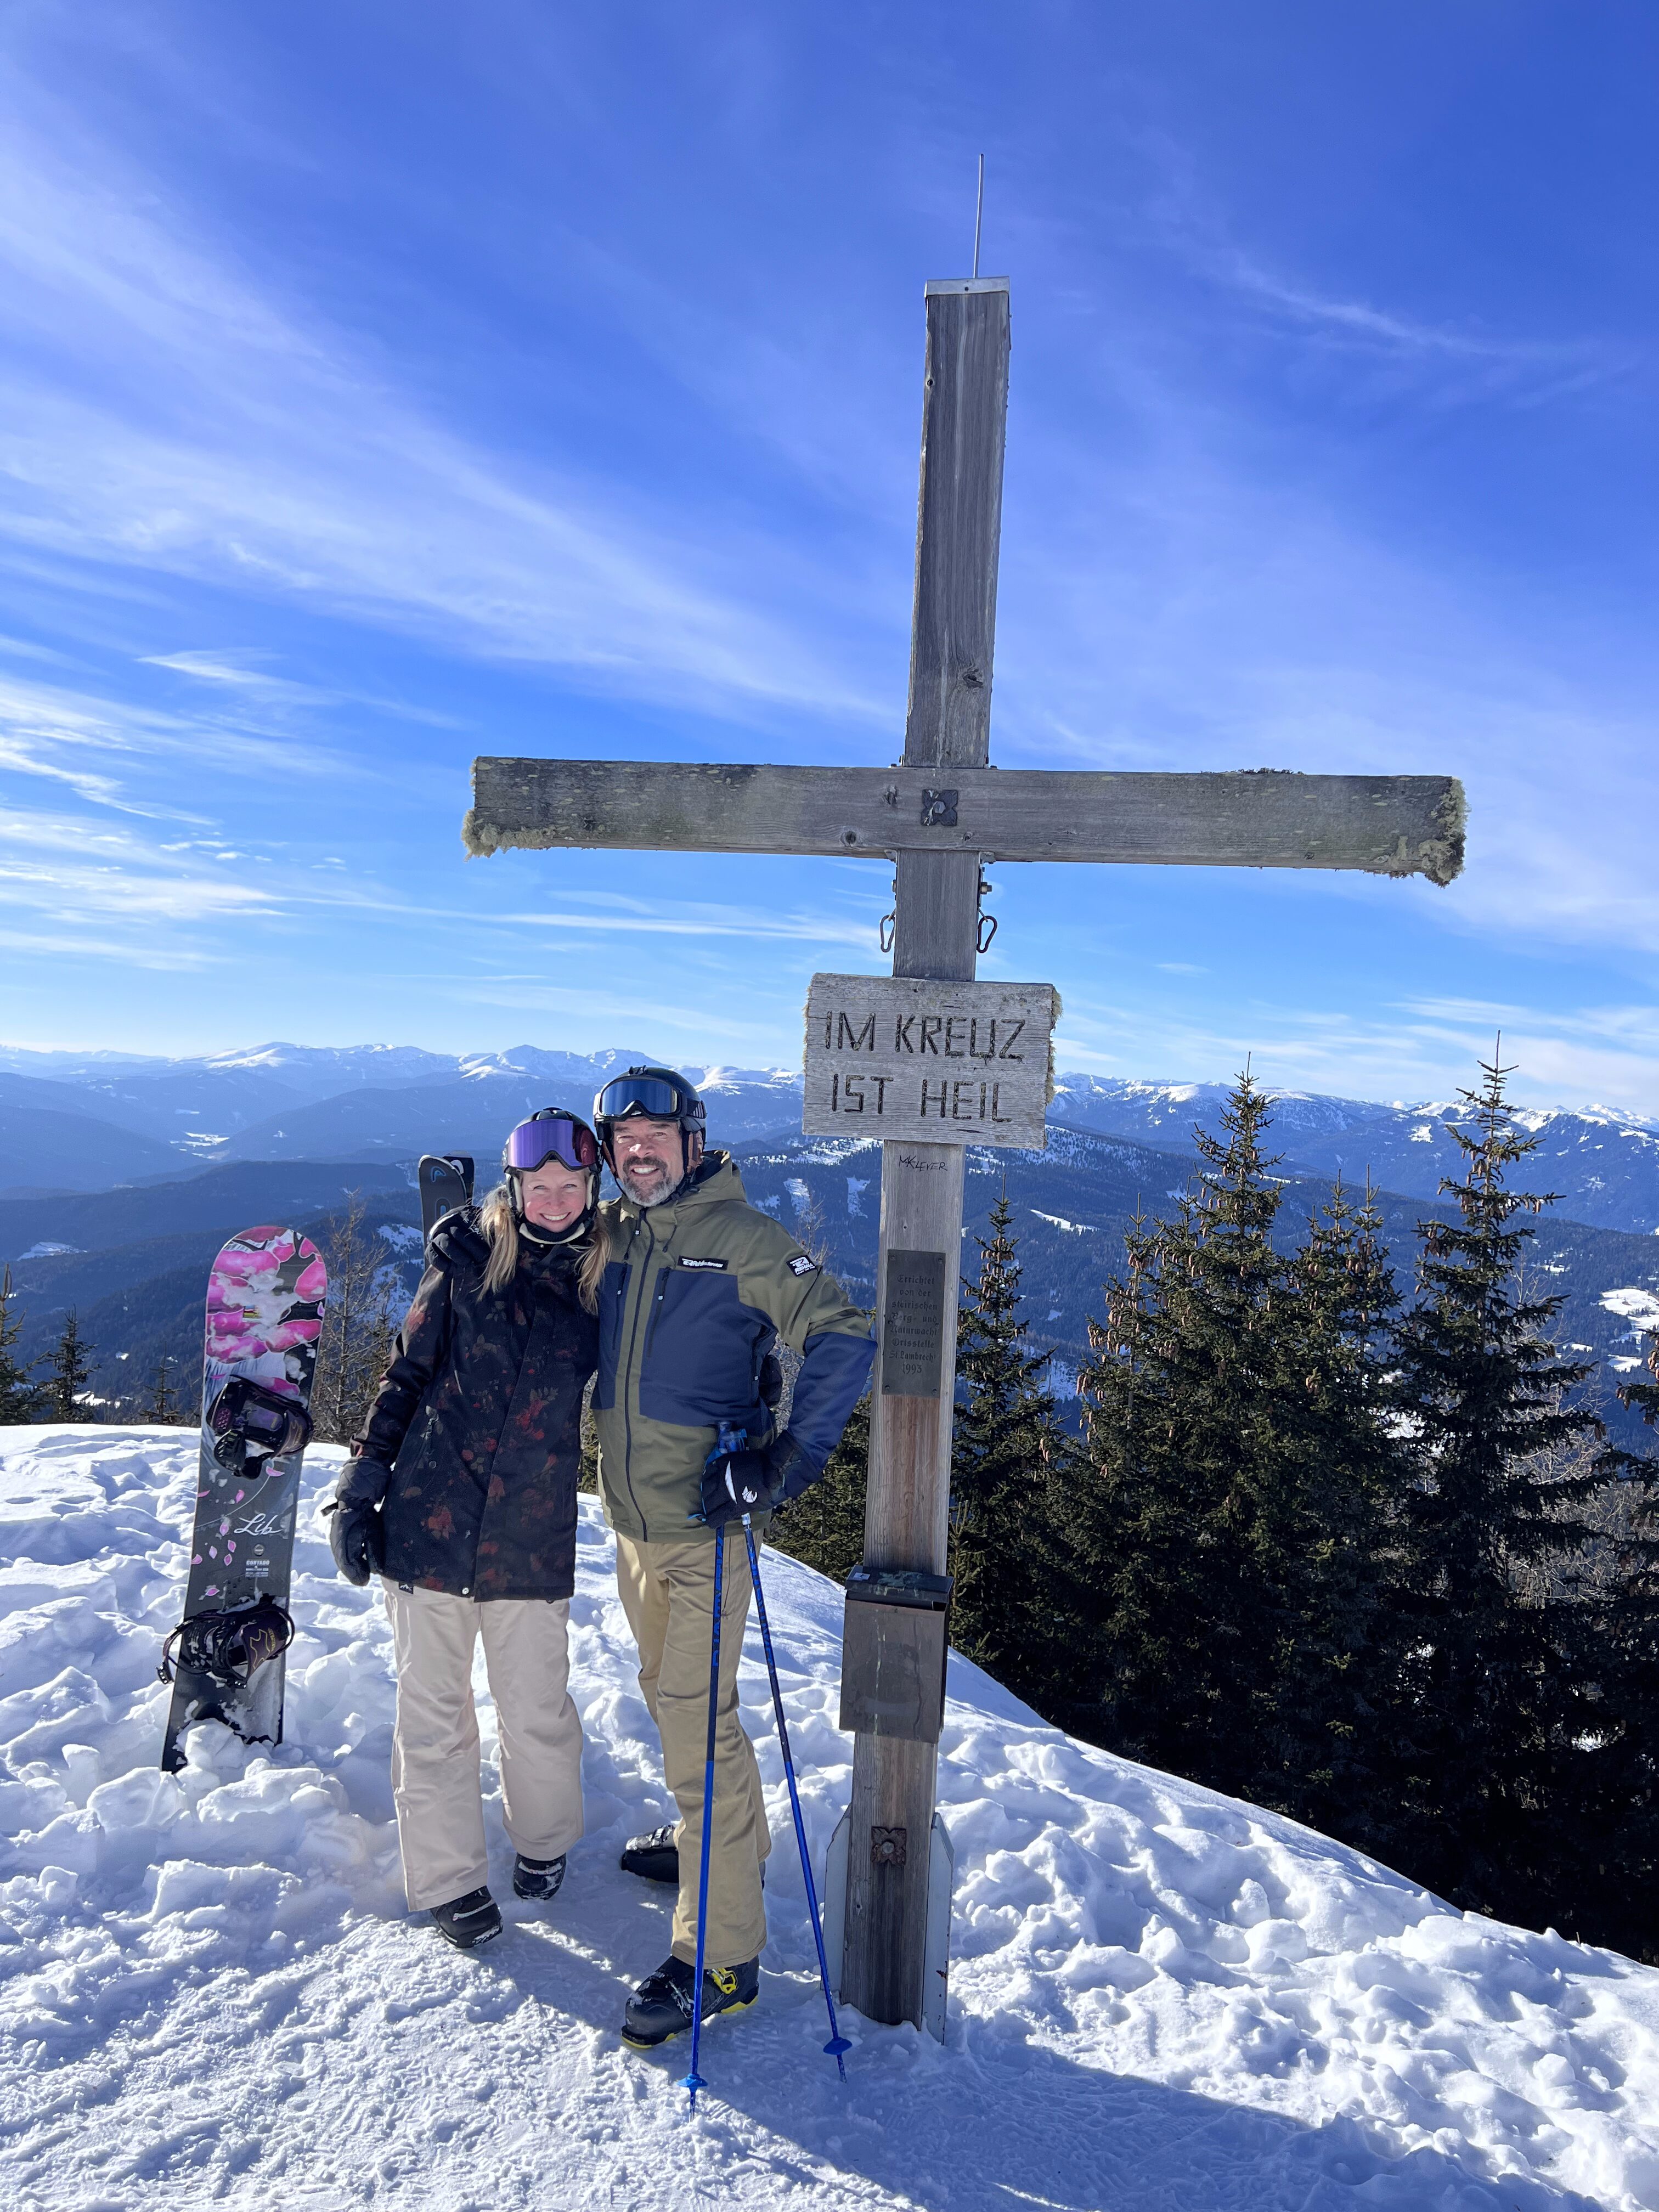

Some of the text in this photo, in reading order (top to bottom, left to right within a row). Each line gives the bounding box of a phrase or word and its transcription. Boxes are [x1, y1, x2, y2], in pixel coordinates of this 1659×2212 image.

[825, 1010, 1026, 1062] IM KREUZ
[831, 1073, 1012, 1122] IST HEIL
[897, 1274, 935, 1285] Errichtet
[918, 1288, 931, 1297] der
[891, 1300, 938, 1312] steirischen
[923, 1314, 938, 1323] und
[890, 1325, 938, 1338] Naturwacht
[891, 1338, 934, 1348] Ortsstelle
[902, 1363, 922, 1375] 1993
[234, 1513, 283, 1536] Lib
